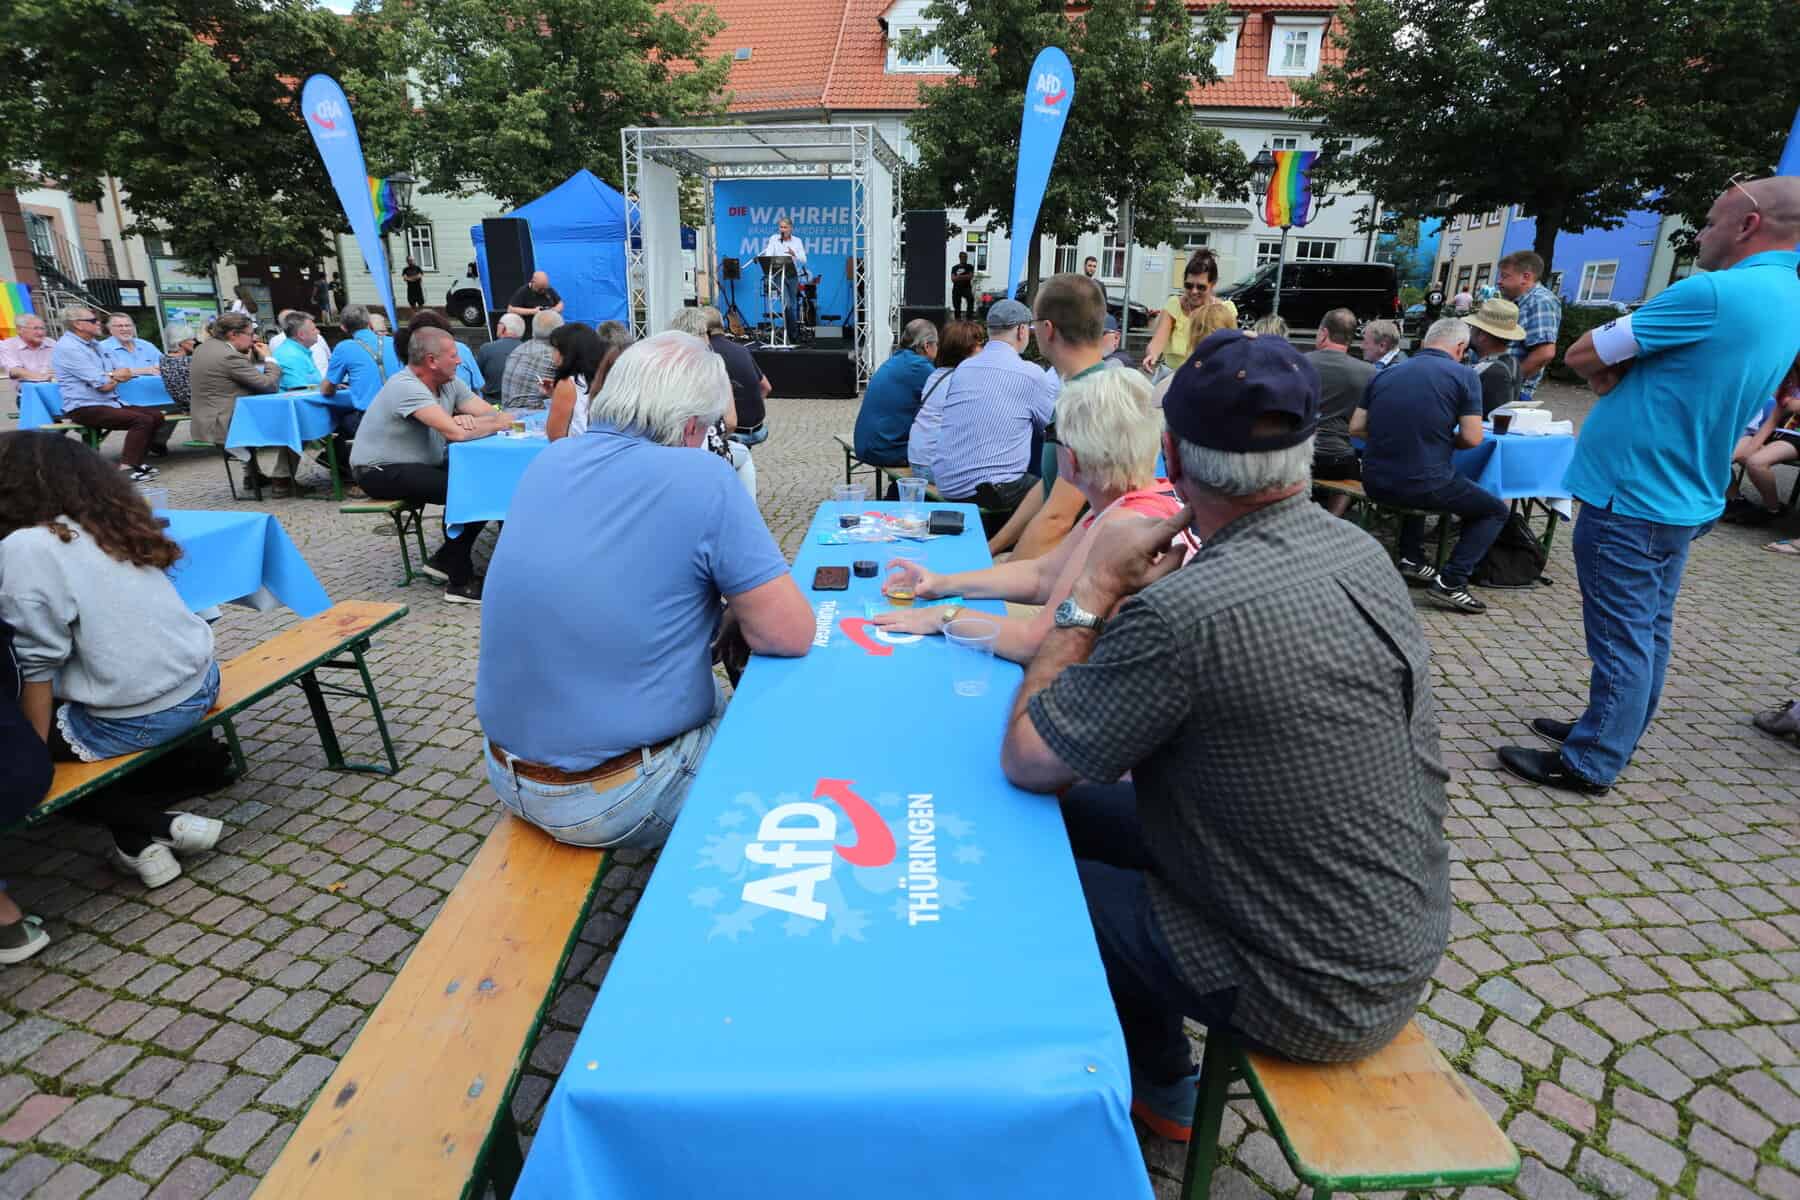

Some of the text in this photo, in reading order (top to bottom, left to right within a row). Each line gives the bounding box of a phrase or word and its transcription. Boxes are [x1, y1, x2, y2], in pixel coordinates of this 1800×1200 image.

[1035, 73, 1061, 94] AfD
[728, 206, 865, 225] DIE WAHRHE
[740, 237, 851, 255] MEHEIT
[741, 802, 837, 921] AfD
[899, 793, 940, 926] THÜRINGEN
